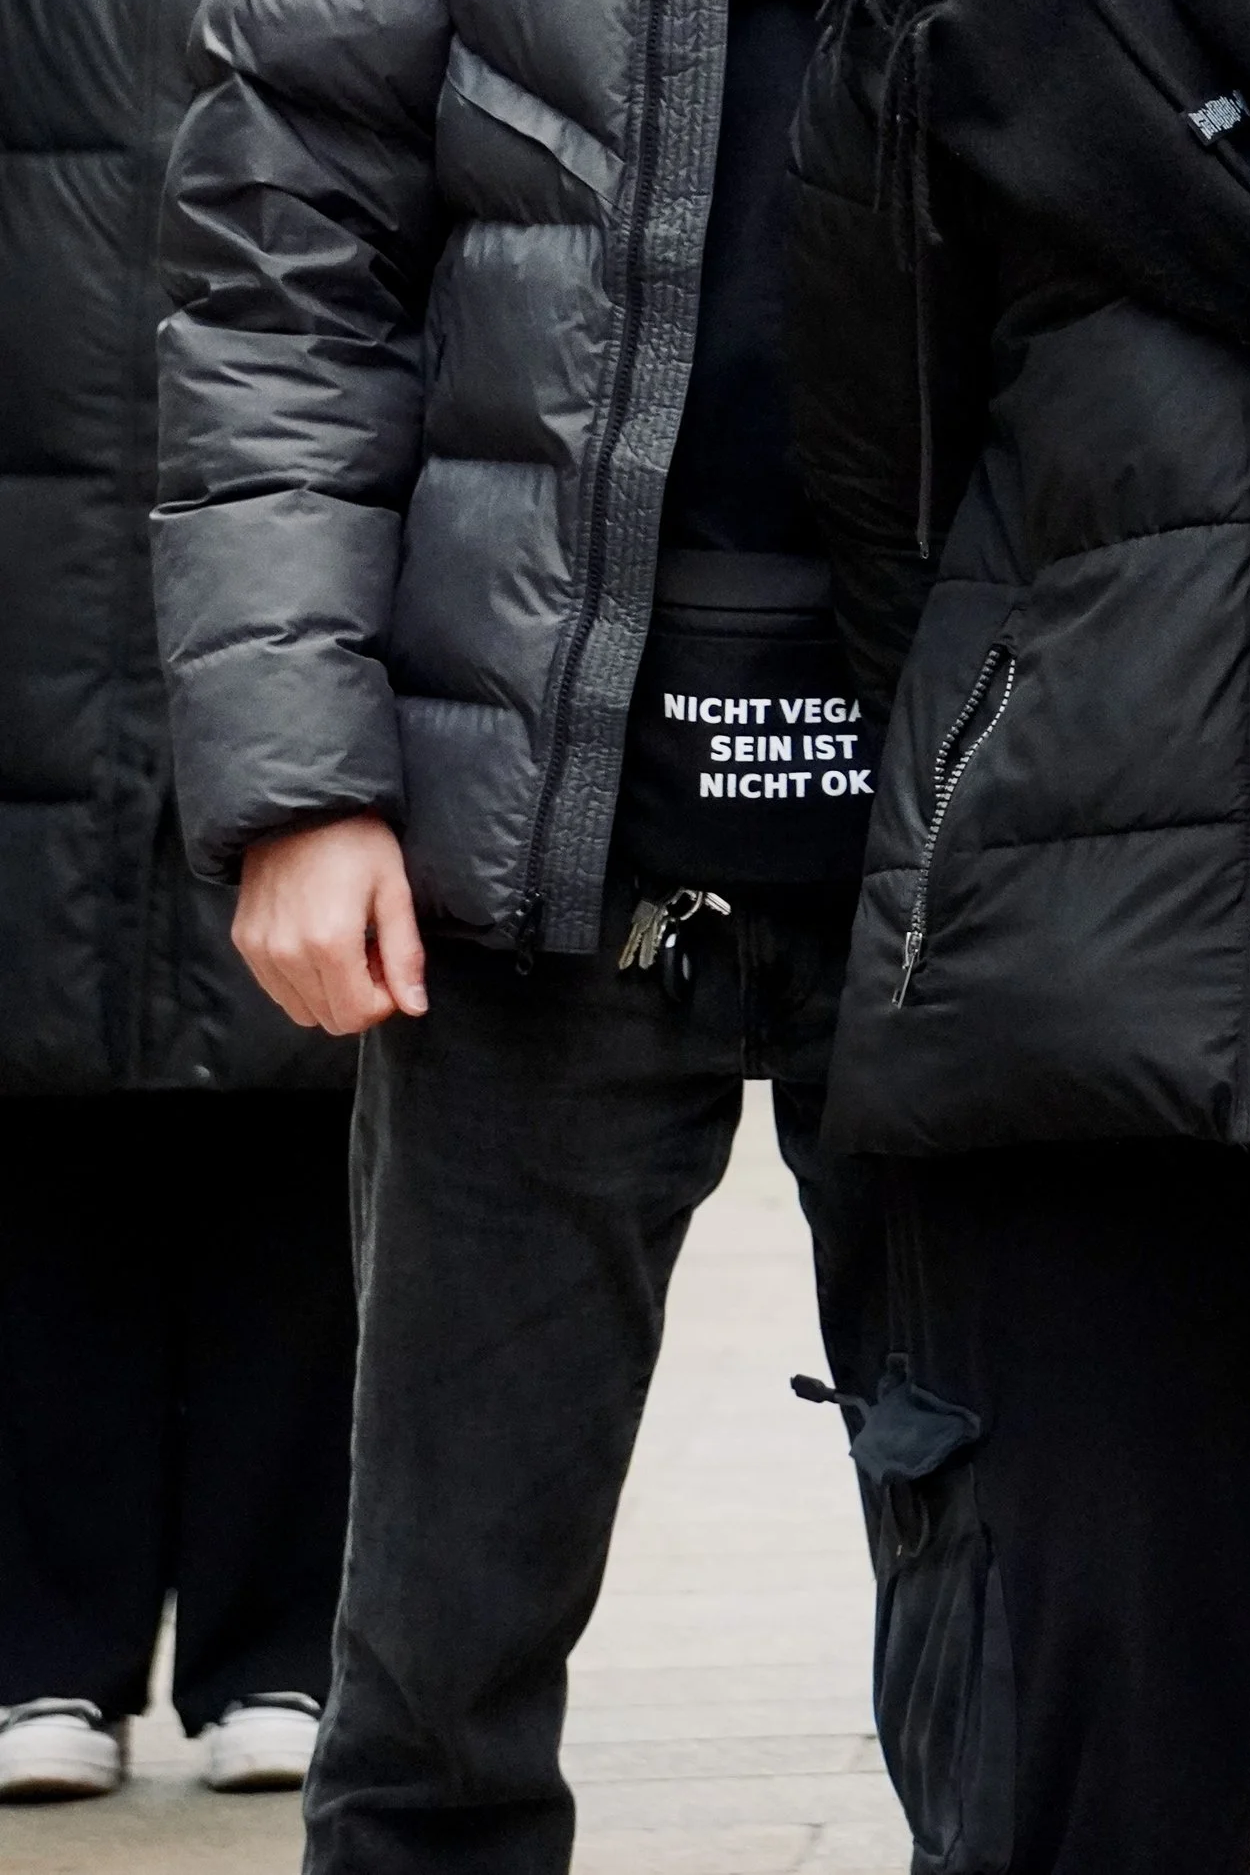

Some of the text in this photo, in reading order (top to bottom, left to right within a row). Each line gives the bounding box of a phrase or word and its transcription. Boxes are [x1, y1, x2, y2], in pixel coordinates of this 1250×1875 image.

[663, 692, 771, 724] NICHT
[710, 734, 858, 762] SEIN IST
[699, 769, 875, 799] NICHT OK
